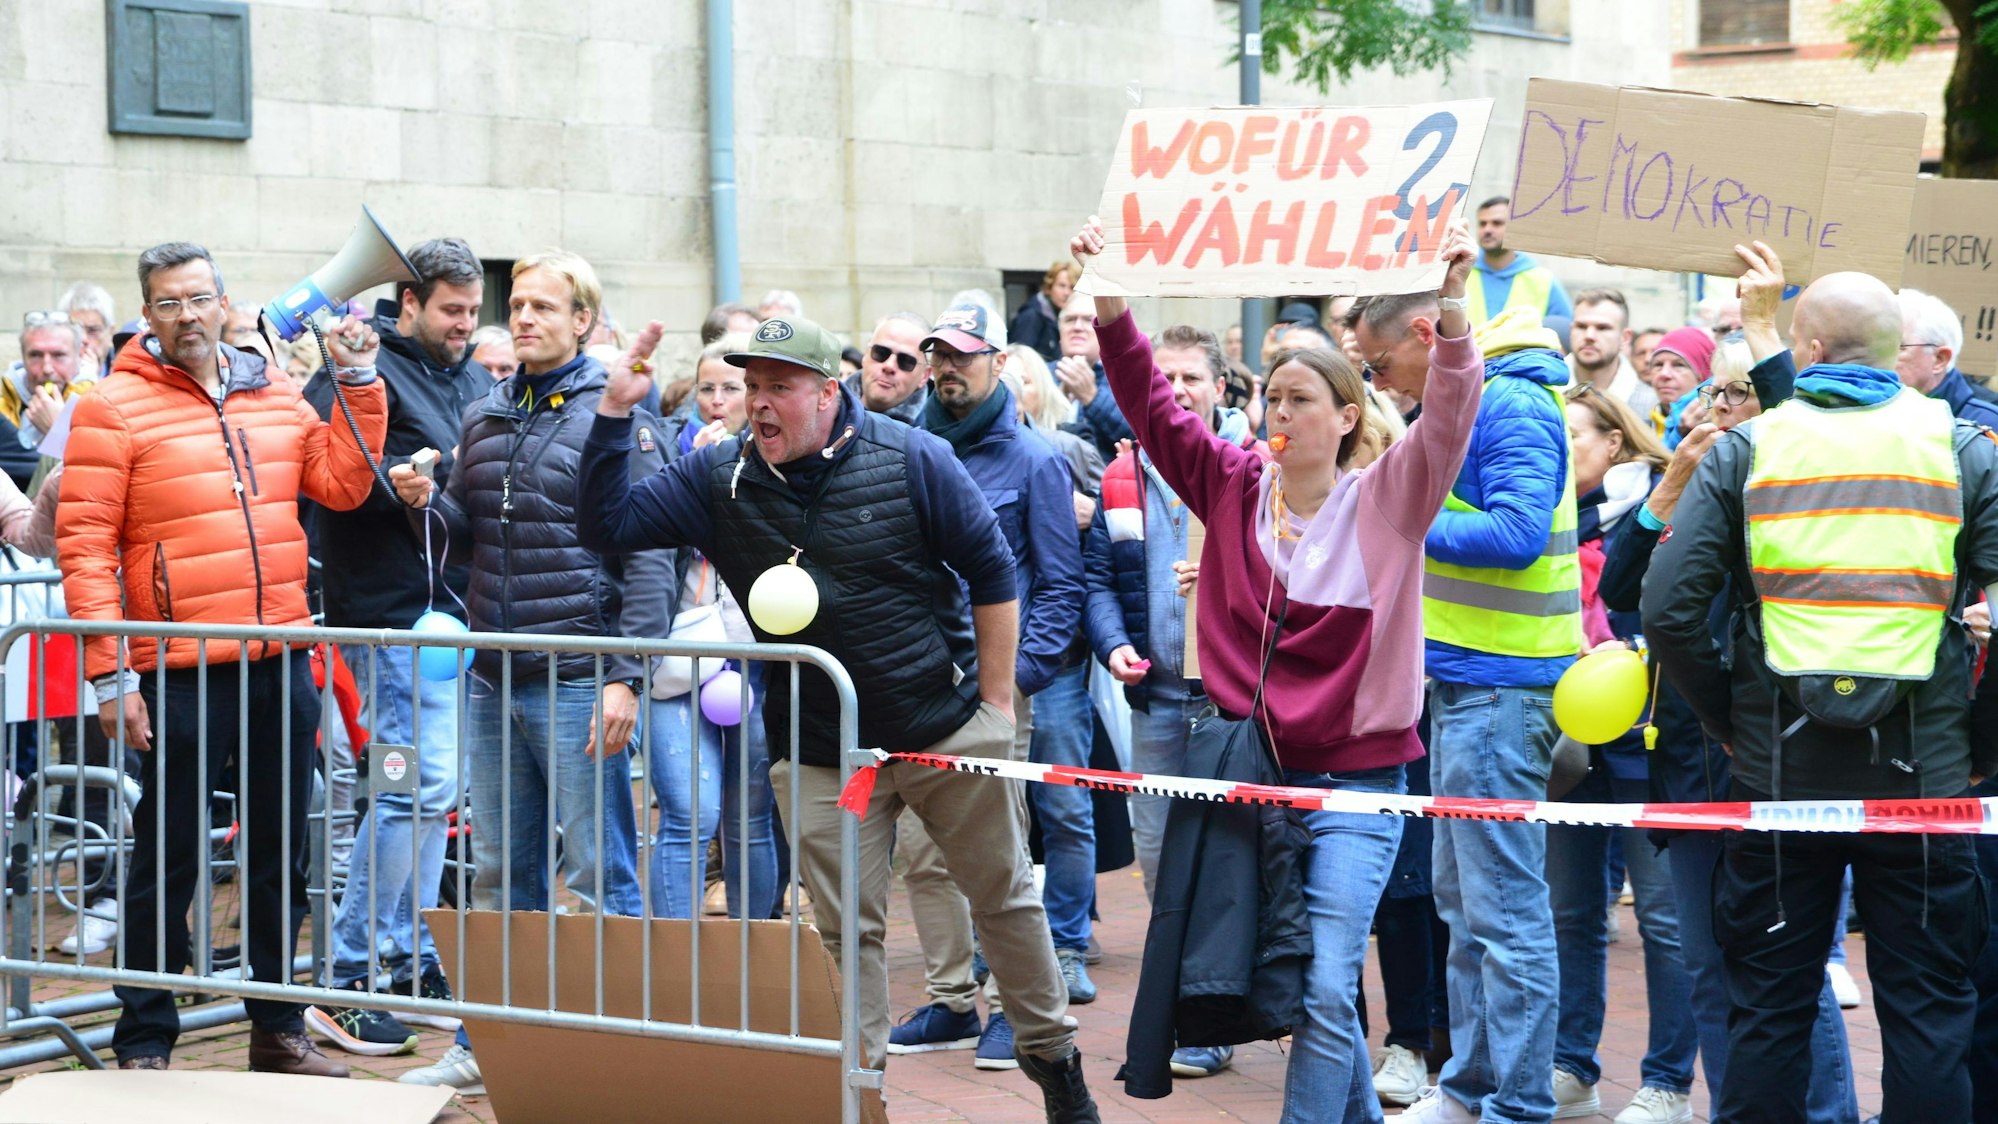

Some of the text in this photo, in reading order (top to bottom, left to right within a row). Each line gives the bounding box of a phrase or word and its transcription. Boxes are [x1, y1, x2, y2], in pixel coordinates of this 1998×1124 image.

[1131, 107, 1371, 181] WOFÜR
[1510, 109, 1842, 249] DEMOKRATIE
[1122, 181, 1460, 270] WÄHLEN
